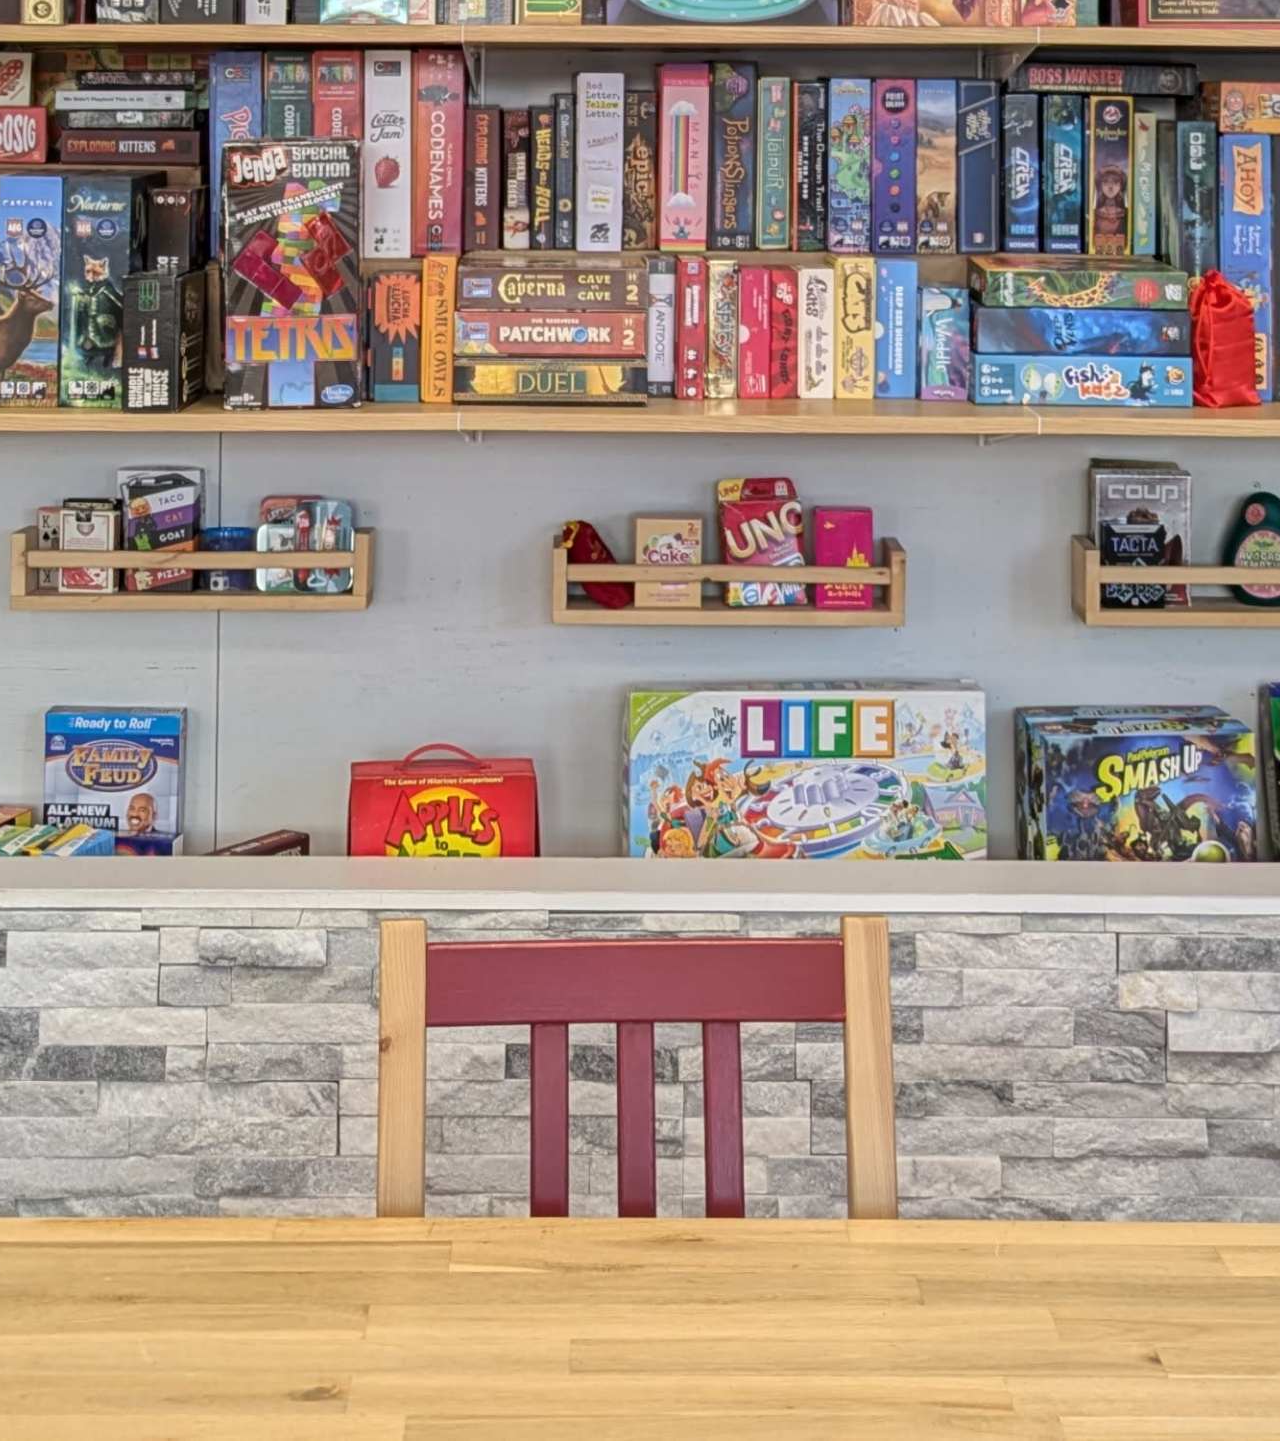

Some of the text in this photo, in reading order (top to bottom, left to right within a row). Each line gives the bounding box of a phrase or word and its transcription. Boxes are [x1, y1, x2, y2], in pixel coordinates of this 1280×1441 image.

[1029, 67, 1124, 85] BOSS MONSTER
[371, 114, 406, 128] Letter
[370, 126, 405, 143] Jam
[118, 141, 156, 153] KITTENS
[291, 146, 350, 160] SPECIAL
[231, 145, 286, 183] Jenga
[291, 162, 350, 178] EDITION
[428, 111, 446, 220] CODENAMES
[1235, 151, 1257, 210] AHOY
[578, 275, 612, 285] CAVE
[498, 274, 566, 303] Caverna
[578, 291, 612, 301] CAVE
[229, 318, 357, 361] TETRIS
[499, 326, 611, 343] PATCHWORK
[518, 371, 578, 394] DUEL
[158, 493, 185, 505] TACO
[165, 512, 184, 524] CAT
[159, 529, 186, 542] GOAT
[724, 501, 804, 560] UNO
[1110, 537, 1160, 553] TACTA
[647, 550, 691, 564] Cake
[157, 568, 188, 581] PIZZA
[75, 717, 152, 732] Ready to Roll
[746, 704, 890, 753] LIFE
[72, 744, 154, 765] FAMILY
[83, 763, 143, 787] FEUD
[1095, 744, 1204, 803] SMASH UP
[47, 804, 108, 817] ALL-NEW
[384, 790, 502, 849] APPLES
[435, 838, 449, 851] to
